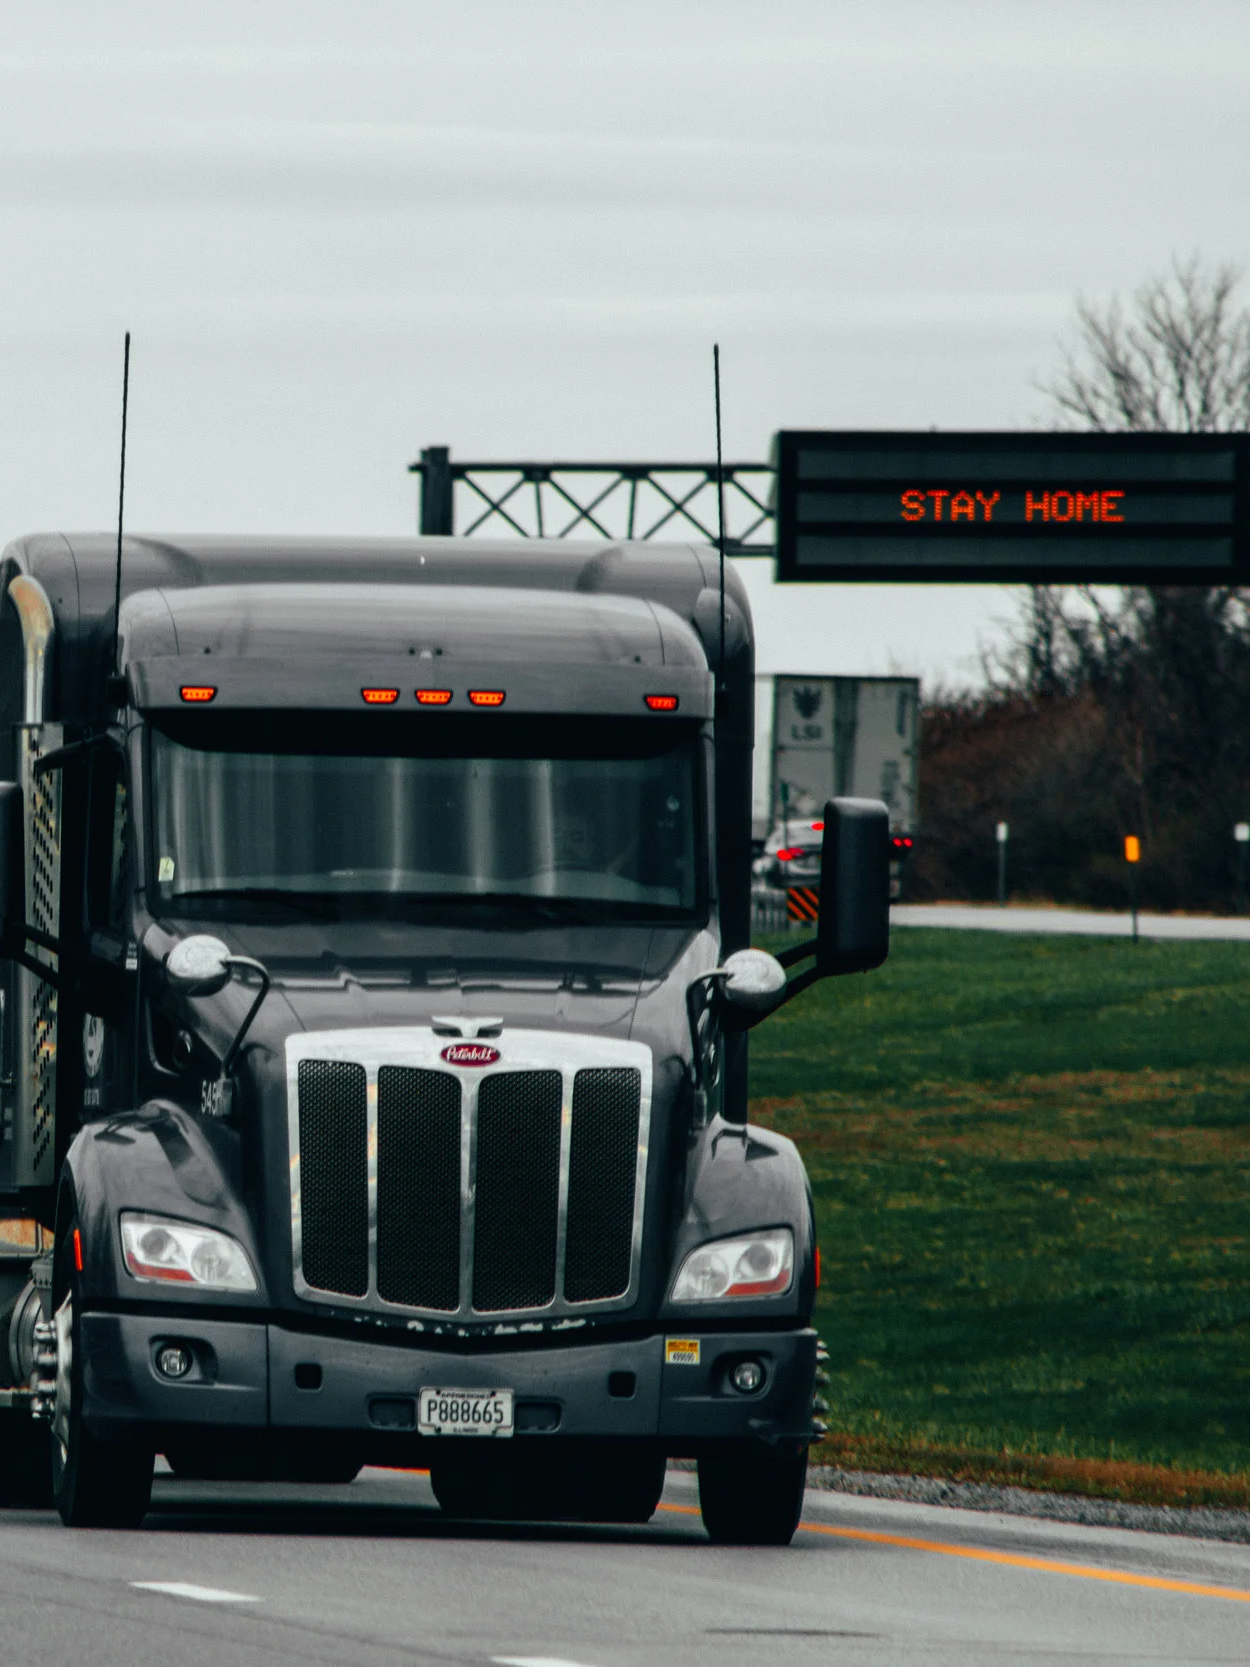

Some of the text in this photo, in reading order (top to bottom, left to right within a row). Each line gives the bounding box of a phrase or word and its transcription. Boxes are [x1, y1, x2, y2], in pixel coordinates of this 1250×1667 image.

[901, 489, 1125, 522] STAY HOME
[446, 1046, 495, 1061] Peterbilt
[428, 1399, 503, 1424] P888665
